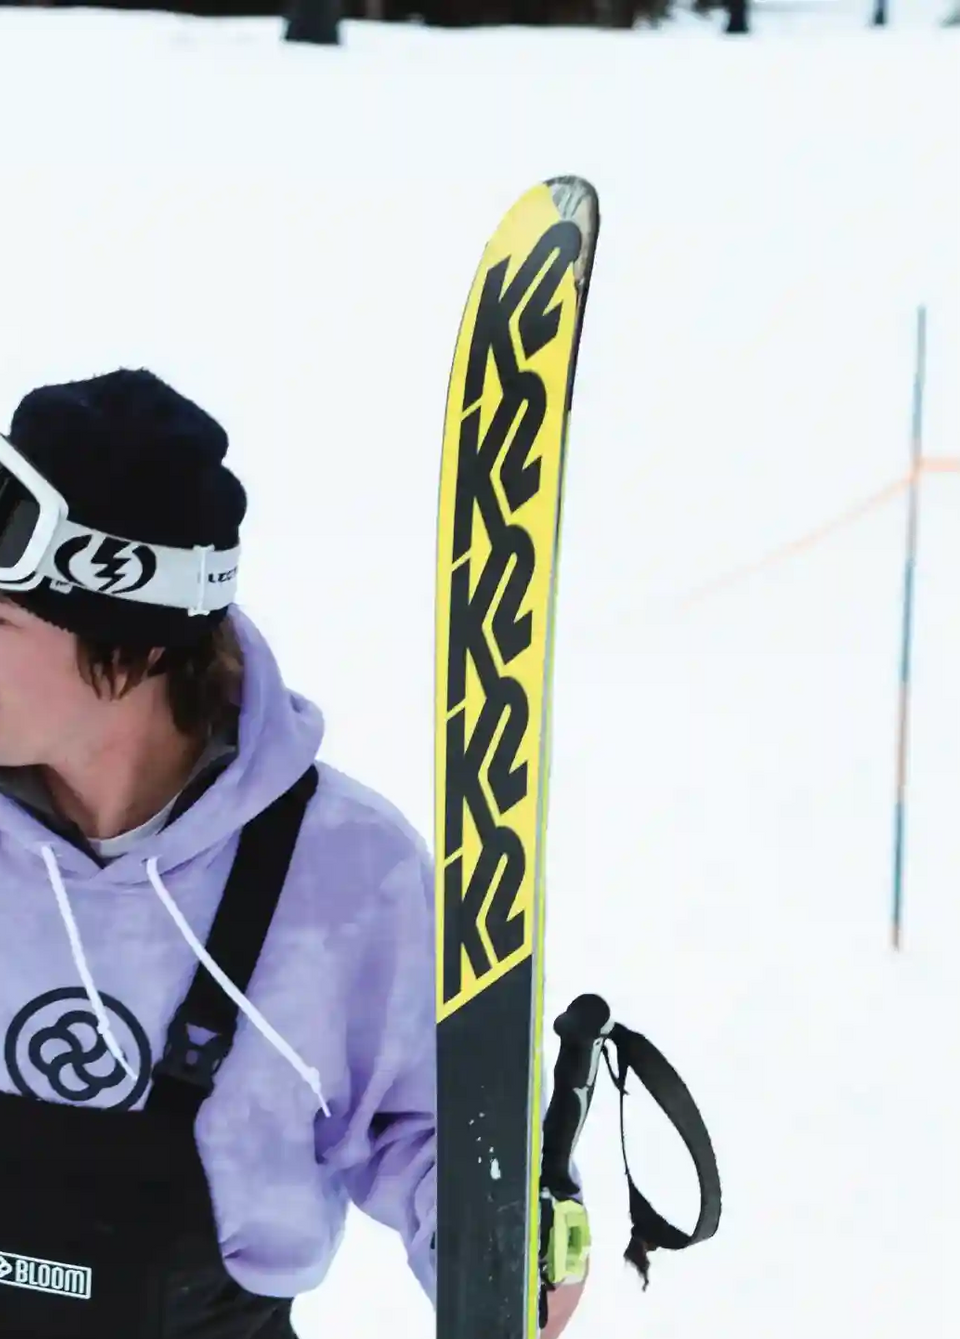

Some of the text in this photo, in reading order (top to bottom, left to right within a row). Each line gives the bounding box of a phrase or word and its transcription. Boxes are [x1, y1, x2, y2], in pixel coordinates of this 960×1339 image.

[463, 221, 582, 410] K2
[452, 370, 547, 564] K2
[447, 524, 535, 713] K2
[444, 676, 529, 860] K2
[443, 825, 526, 1005] K2
[15, 1259, 85, 1294] BLOOM
